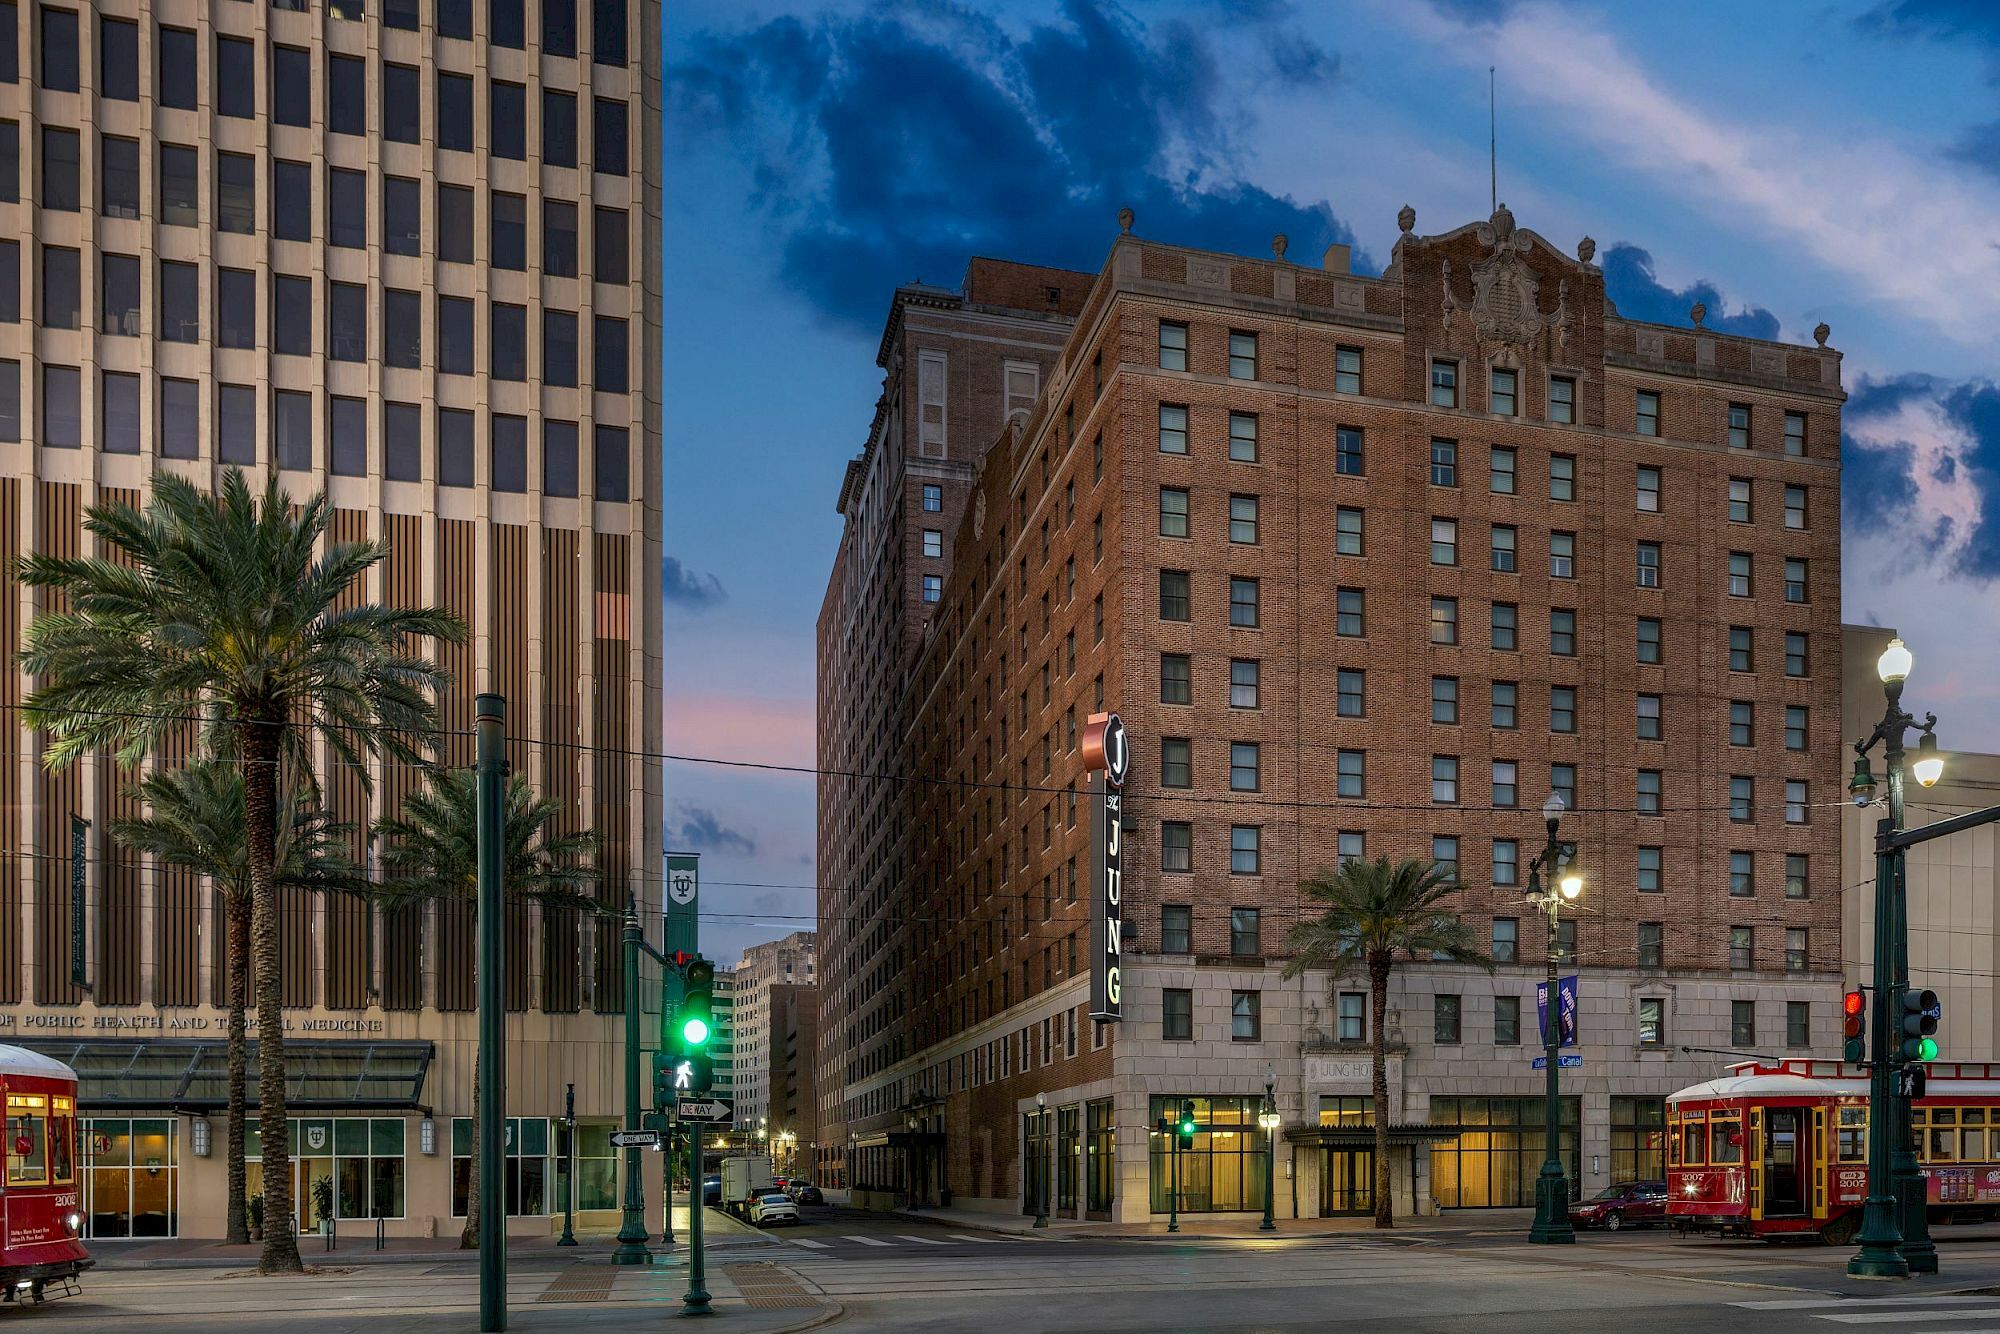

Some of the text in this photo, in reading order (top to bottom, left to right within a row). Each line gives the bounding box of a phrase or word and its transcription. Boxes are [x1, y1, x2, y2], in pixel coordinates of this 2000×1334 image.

[1113, 729, 1124, 774] J
[1107, 820, 1120, 1005] JUNG
[1561, 987, 1576, 1011] DOWN
[24, 1016, 85, 1028] PUBLIC
[91, 1017, 162, 1029] HEALTH
[170, 1018, 208, 1030] AND
[302, 1019, 382, 1032] MEDICINE
[1562, 1056, 1582, 1066] Canal
[1323, 1063, 1374, 1077] JUNG HOT
[681, 1104, 712, 1115] ONE WAY
[1681, 1173, 1705, 1181] 2007
[1839, 1180, 1867, 1188] 2007
[55, 1195, 76, 1207] 2002
